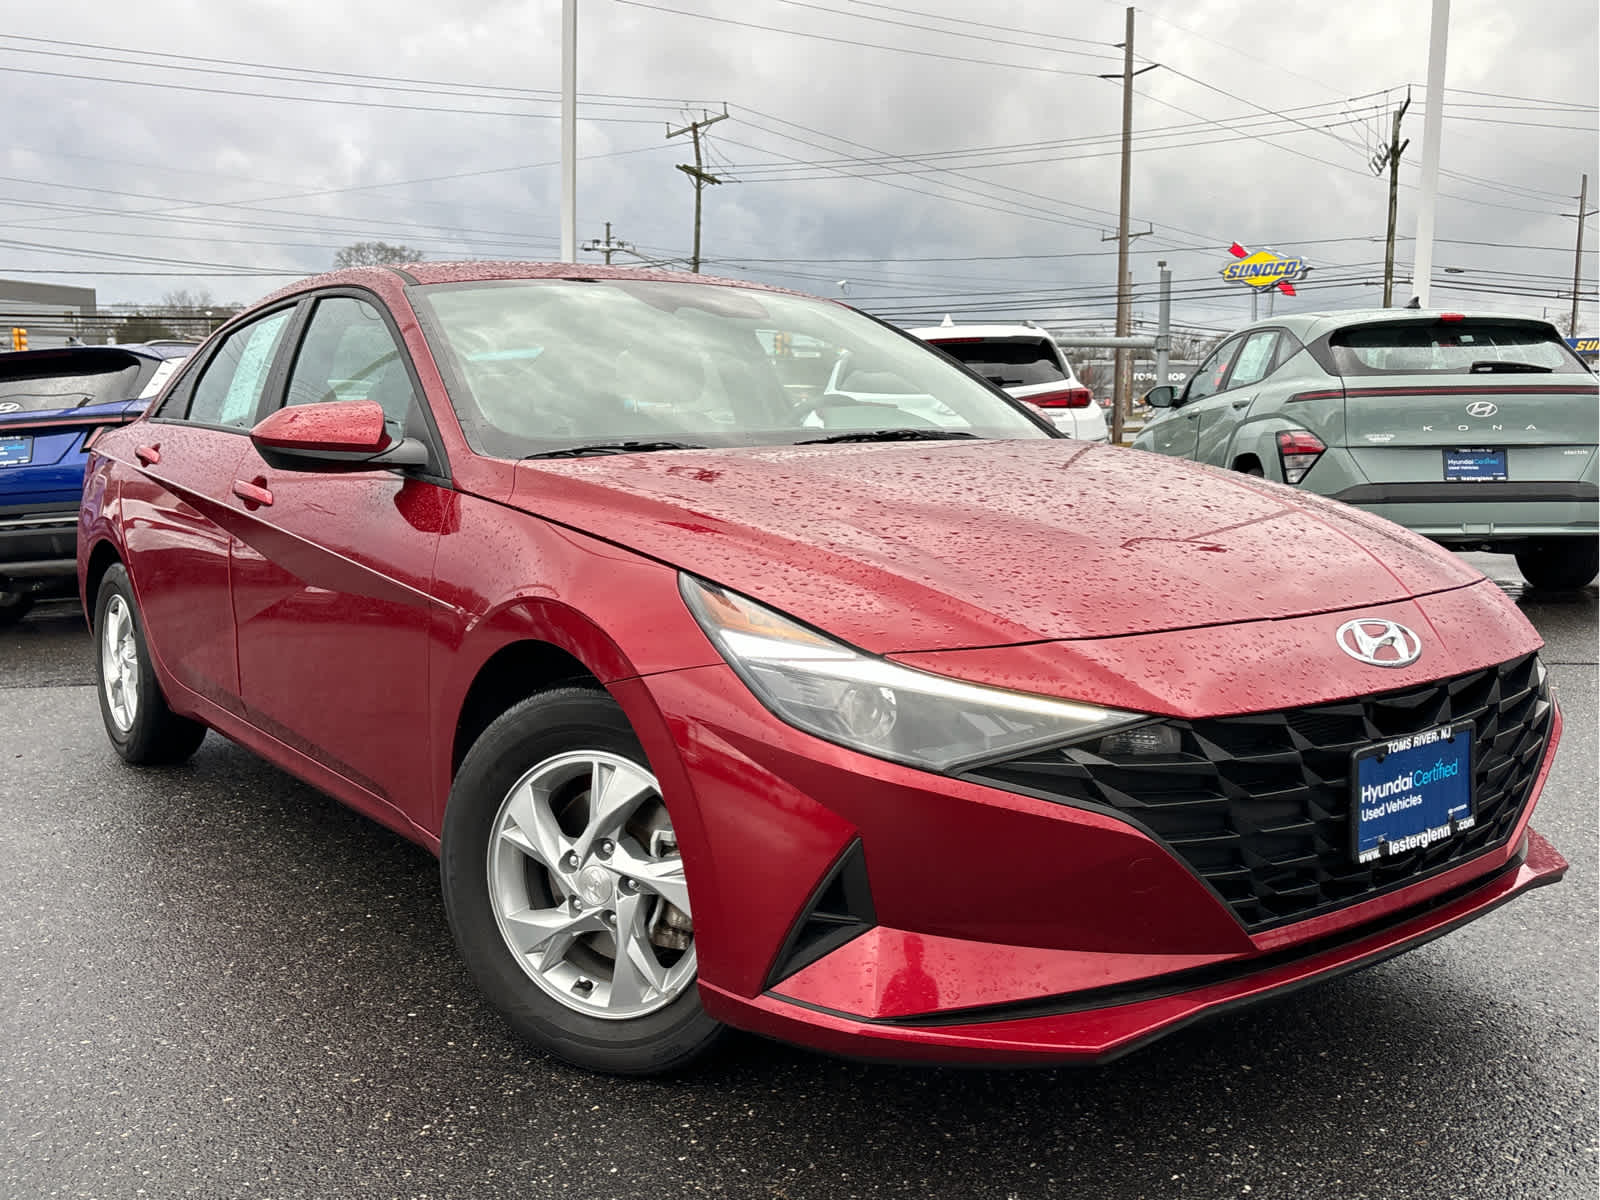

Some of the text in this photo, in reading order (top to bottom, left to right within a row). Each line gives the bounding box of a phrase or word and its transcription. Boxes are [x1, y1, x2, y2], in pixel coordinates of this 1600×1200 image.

[1227, 261, 1298, 279] SUNOCO
[1423, 424, 1537, 432] KONA
[1387, 737, 1412, 754] TOMS
[1440, 727, 1452, 740] NJ
[1361, 758, 1458, 804] Hyundai Certified
[1361, 794, 1422, 822] Used Vehicles
[1388, 825, 1451, 855] lesterglenn
